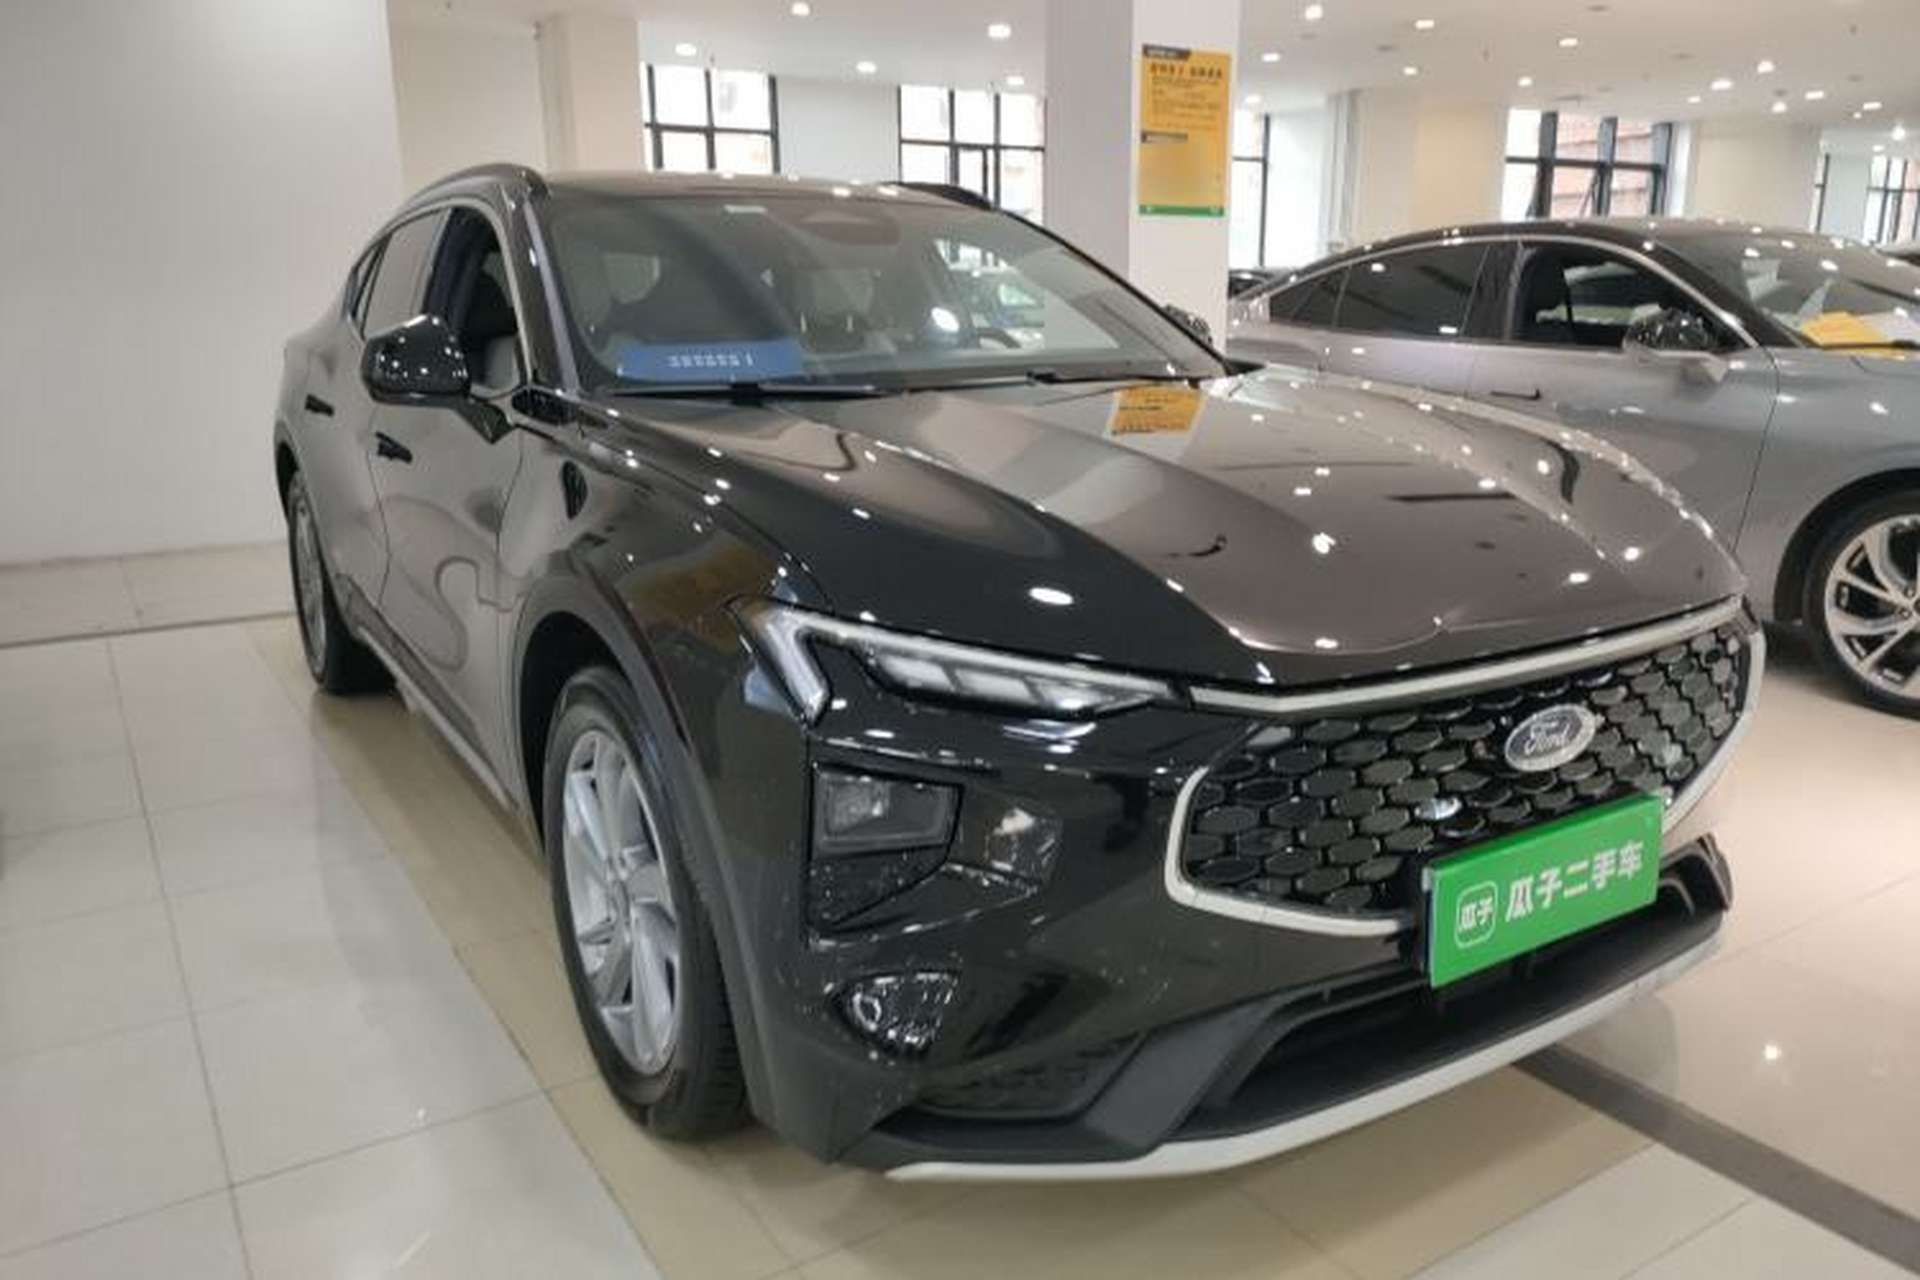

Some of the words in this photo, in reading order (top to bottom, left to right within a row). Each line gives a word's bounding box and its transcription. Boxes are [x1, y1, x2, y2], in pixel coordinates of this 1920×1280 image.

[1523, 720, 1571, 756] Ford
[1459, 896, 1493, 931] 瓜子
[1506, 842, 1643, 921] 瓜子二手车
